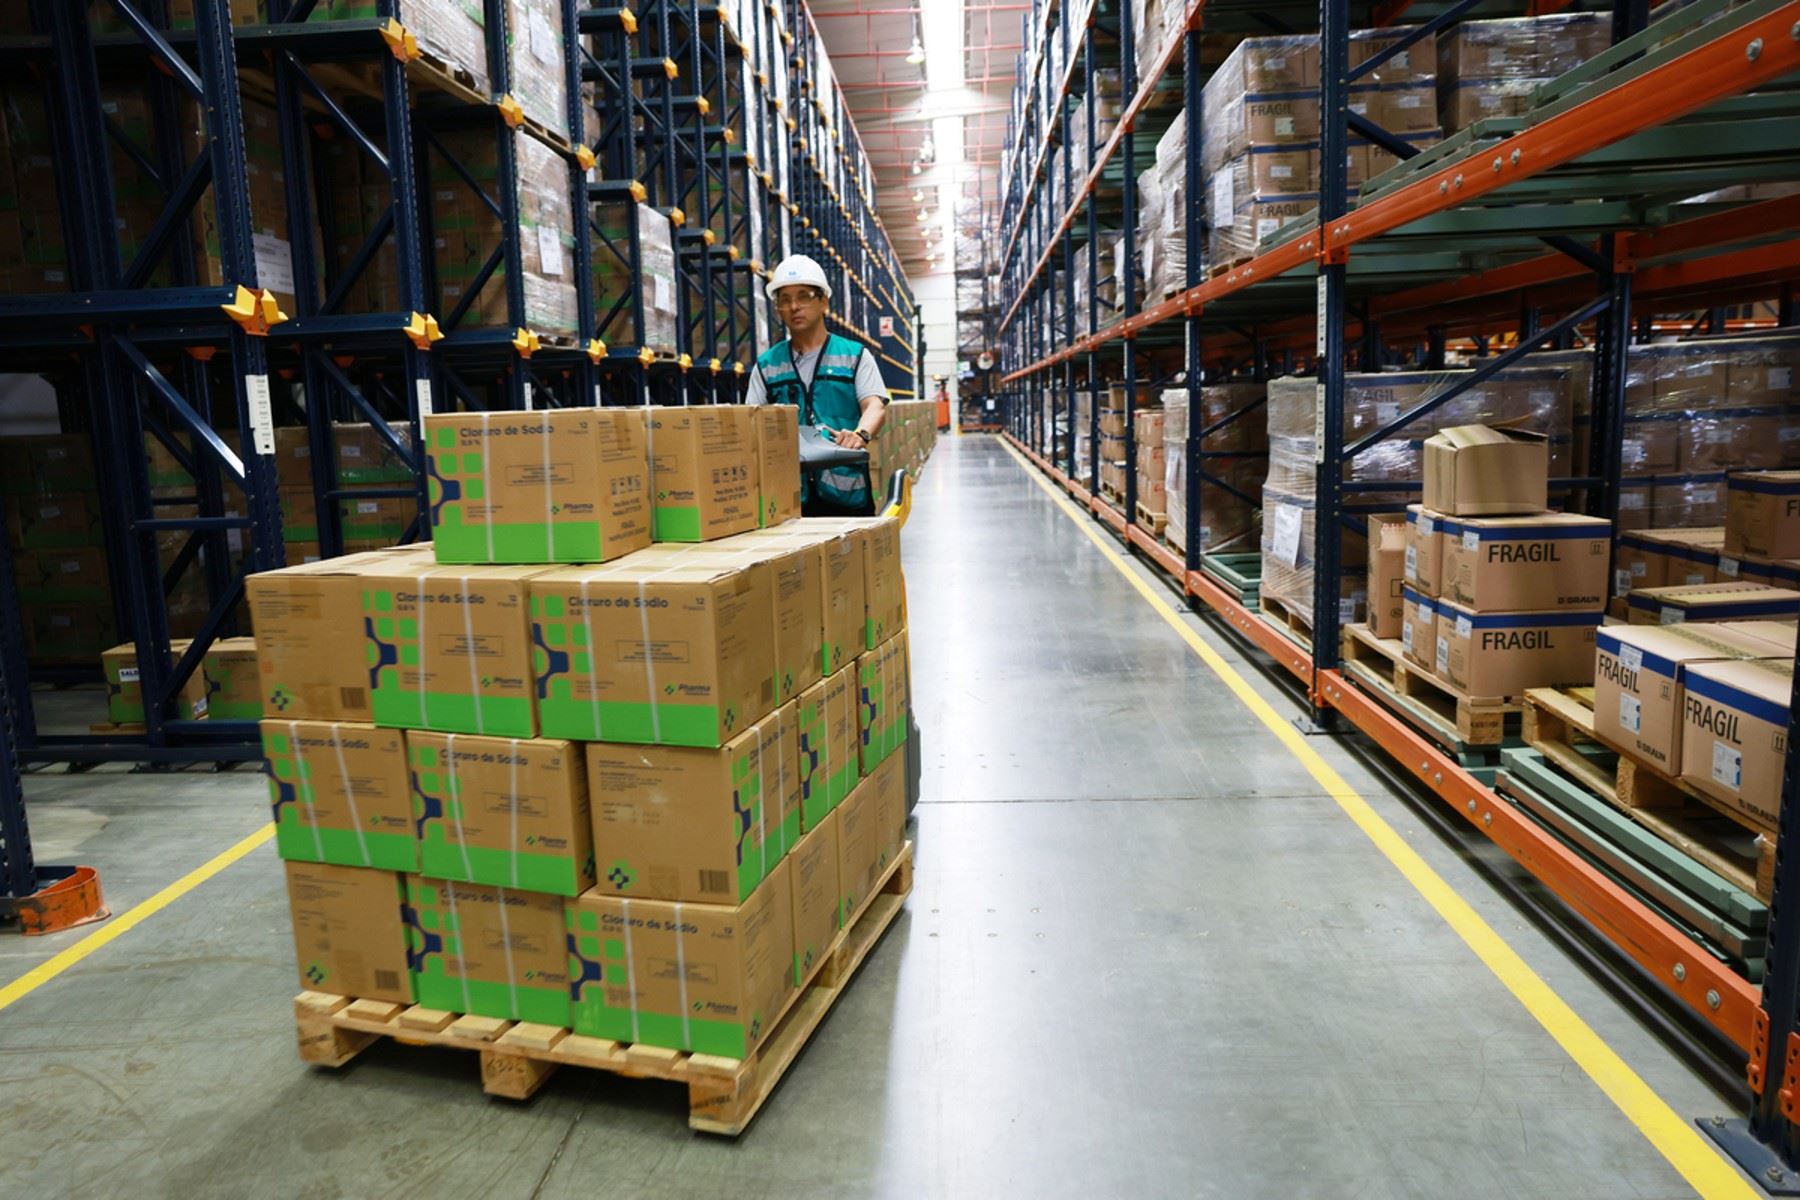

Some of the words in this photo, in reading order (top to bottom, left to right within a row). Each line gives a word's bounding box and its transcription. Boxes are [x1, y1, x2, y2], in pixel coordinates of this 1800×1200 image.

[1259, 203, 1303, 217] RAGIL
[460, 427, 502, 437] Clorro
[504, 425, 519, 435] de
[521, 424, 554, 435] Sodo
[1488, 543, 1561, 563] FRAGIL
[396, 592, 435, 602] Clorro
[615, 597, 630, 608] de
[1482, 630, 1555, 651] FRAGIL
[1598, 654, 1640, 694] FRAGIL
[1685, 695, 1742, 745] FRAGIL
[440, 749, 478, 761] Coruro
[497, 753, 528, 766] Soio
[601, 914, 643, 927] Clorro
